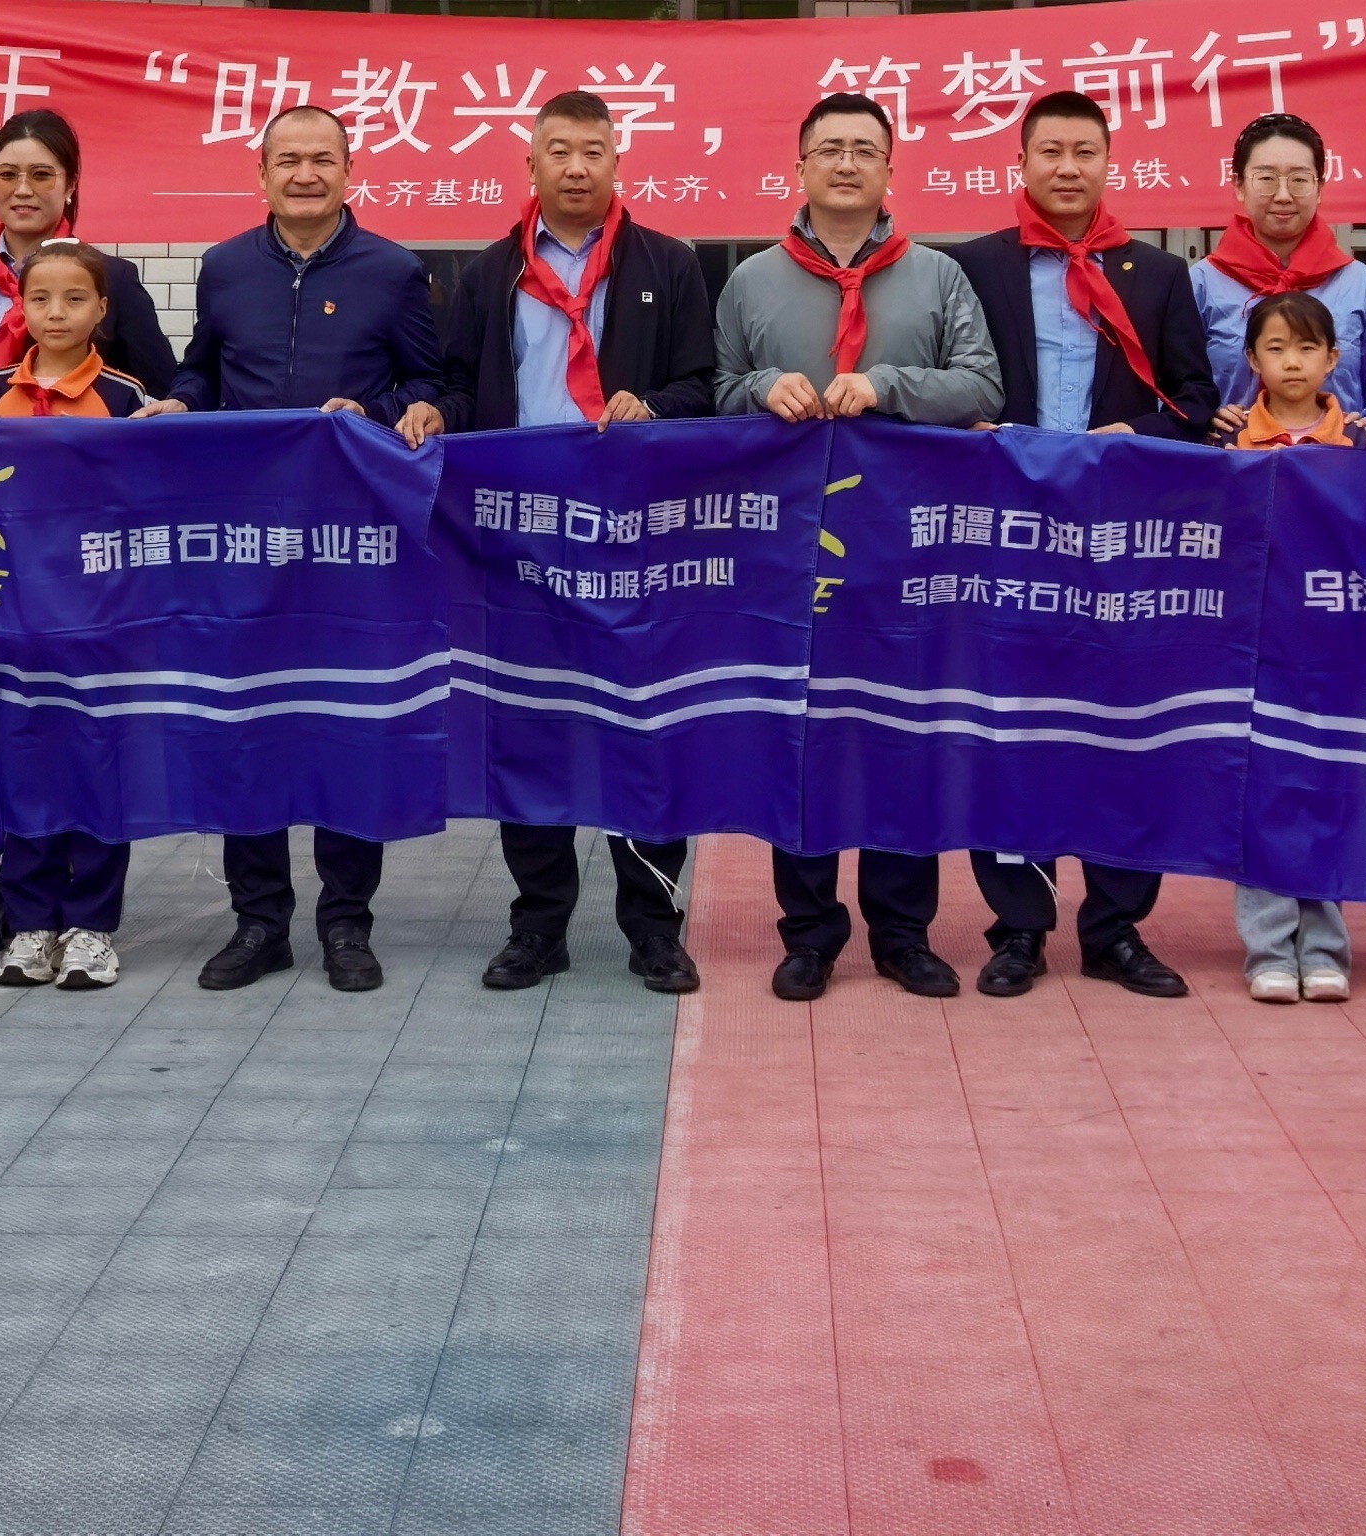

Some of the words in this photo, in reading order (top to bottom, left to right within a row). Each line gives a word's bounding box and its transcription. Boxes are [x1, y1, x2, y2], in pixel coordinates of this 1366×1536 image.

[473, 487, 780, 545] 新疆石油事业部
[909, 504, 1223, 563] 新疆石油事业部
[80, 523, 399, 574] 新疆石油事业部
[516, 557, 736, 601] 库尔勒服务中心
[900, 574, 1224, 623] 乌鲁木齐石化服务中心
